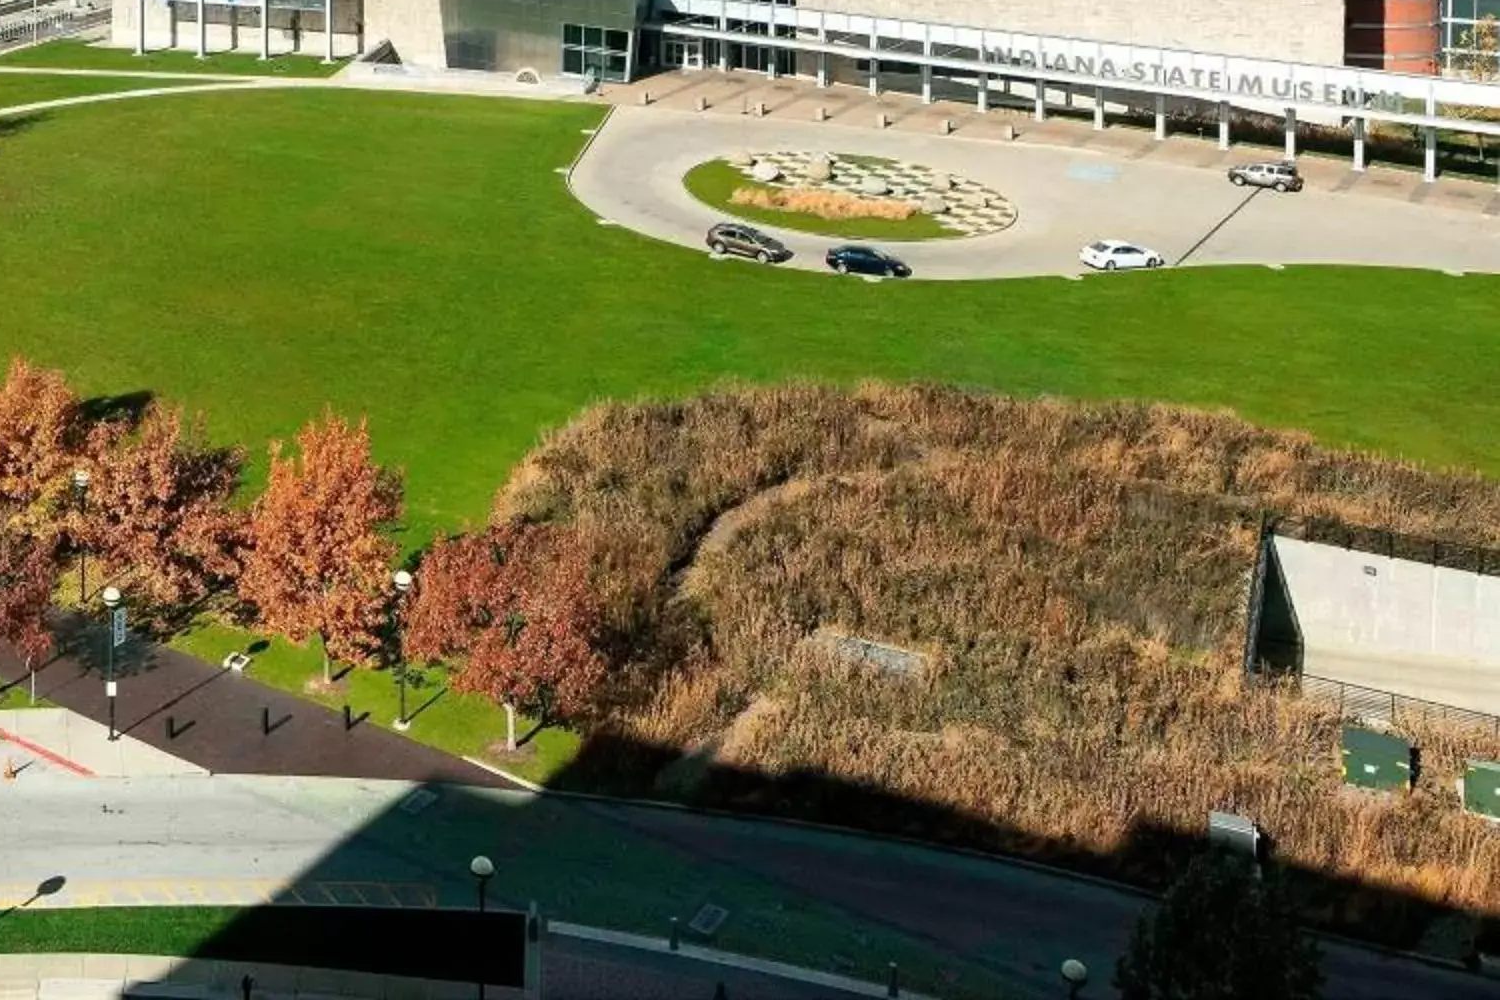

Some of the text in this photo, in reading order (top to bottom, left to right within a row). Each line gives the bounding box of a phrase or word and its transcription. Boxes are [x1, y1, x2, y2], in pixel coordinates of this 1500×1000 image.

[981, 45, 1402, 111] INDIANA STATE MUSEUM
